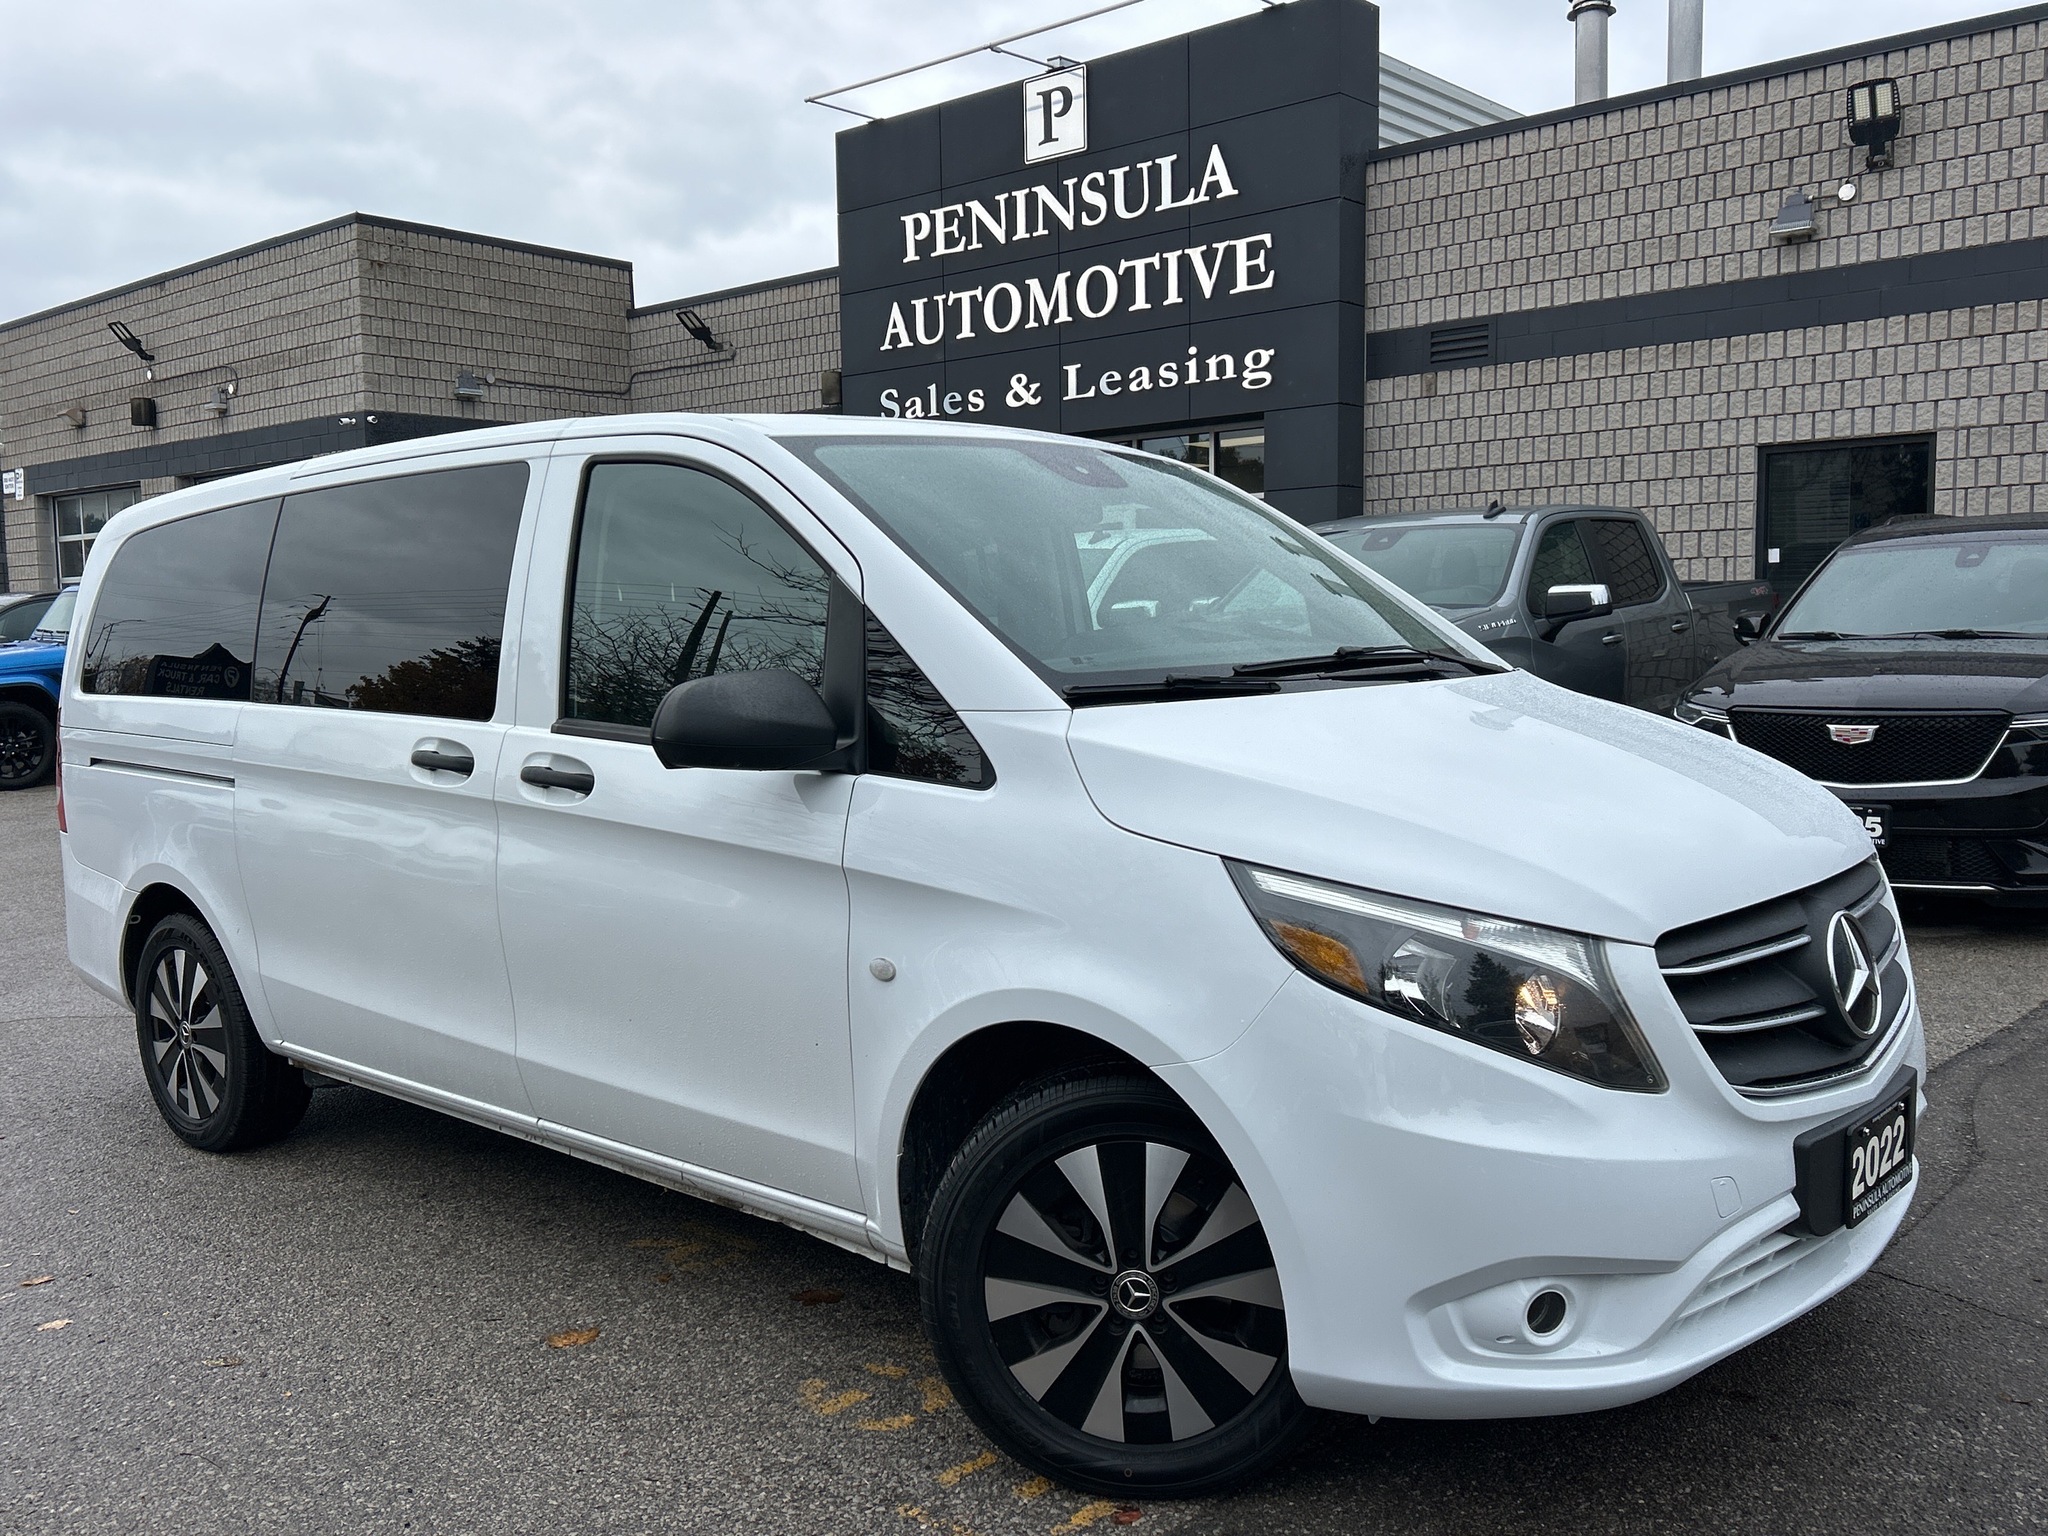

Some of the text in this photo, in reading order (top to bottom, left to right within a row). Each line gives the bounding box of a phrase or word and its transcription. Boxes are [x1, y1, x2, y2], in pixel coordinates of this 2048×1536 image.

[1036, 85, 1073, 147] P
[900, 143, 1239, 264] PENINSULA
[879, 233, 1275, 352] AUTOMOTIVE
[879, 346, 1276, 419] Sales & Leasing
[1852, 1115, 1905, 1200] 2022
